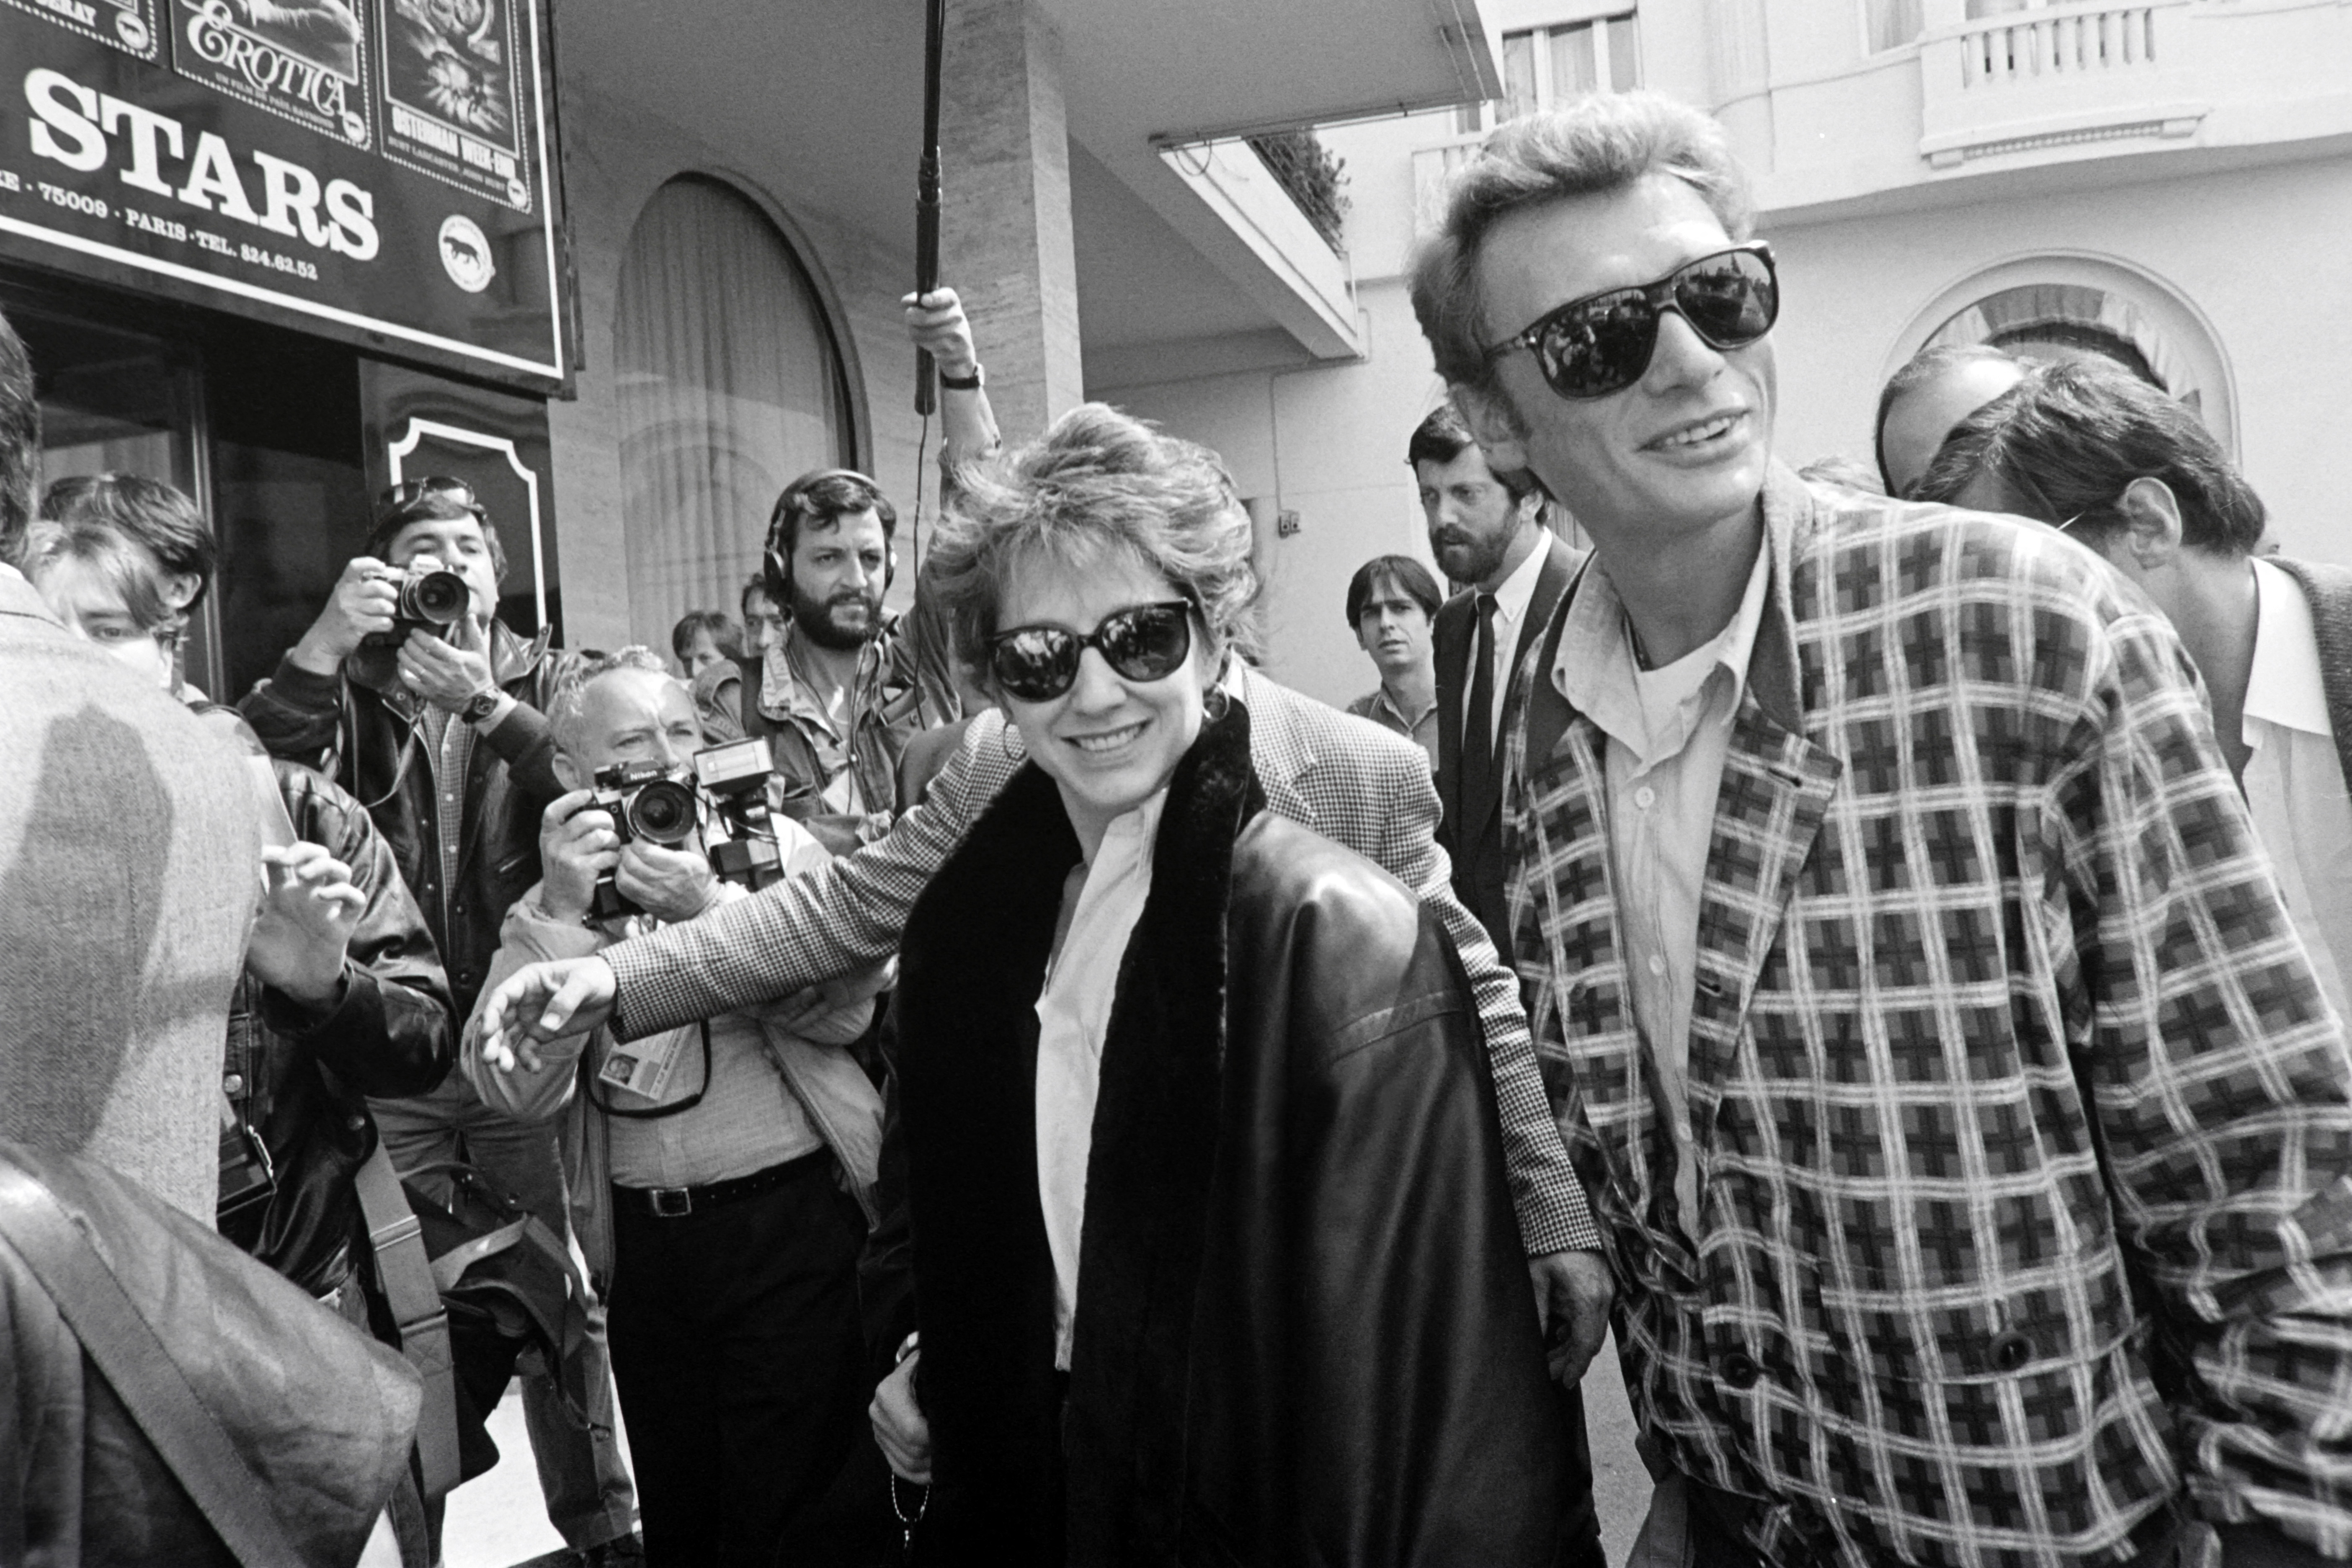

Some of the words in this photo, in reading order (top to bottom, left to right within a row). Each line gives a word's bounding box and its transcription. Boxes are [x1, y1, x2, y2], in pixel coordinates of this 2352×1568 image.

[187, 0, 346, 117] EROTICA
[24, 67, 379, 261] STARS
[37, 181, 108, 219] 75009
[125, 206, 187, 242] PARIS
[630, 770, 657, 781] Nikon
